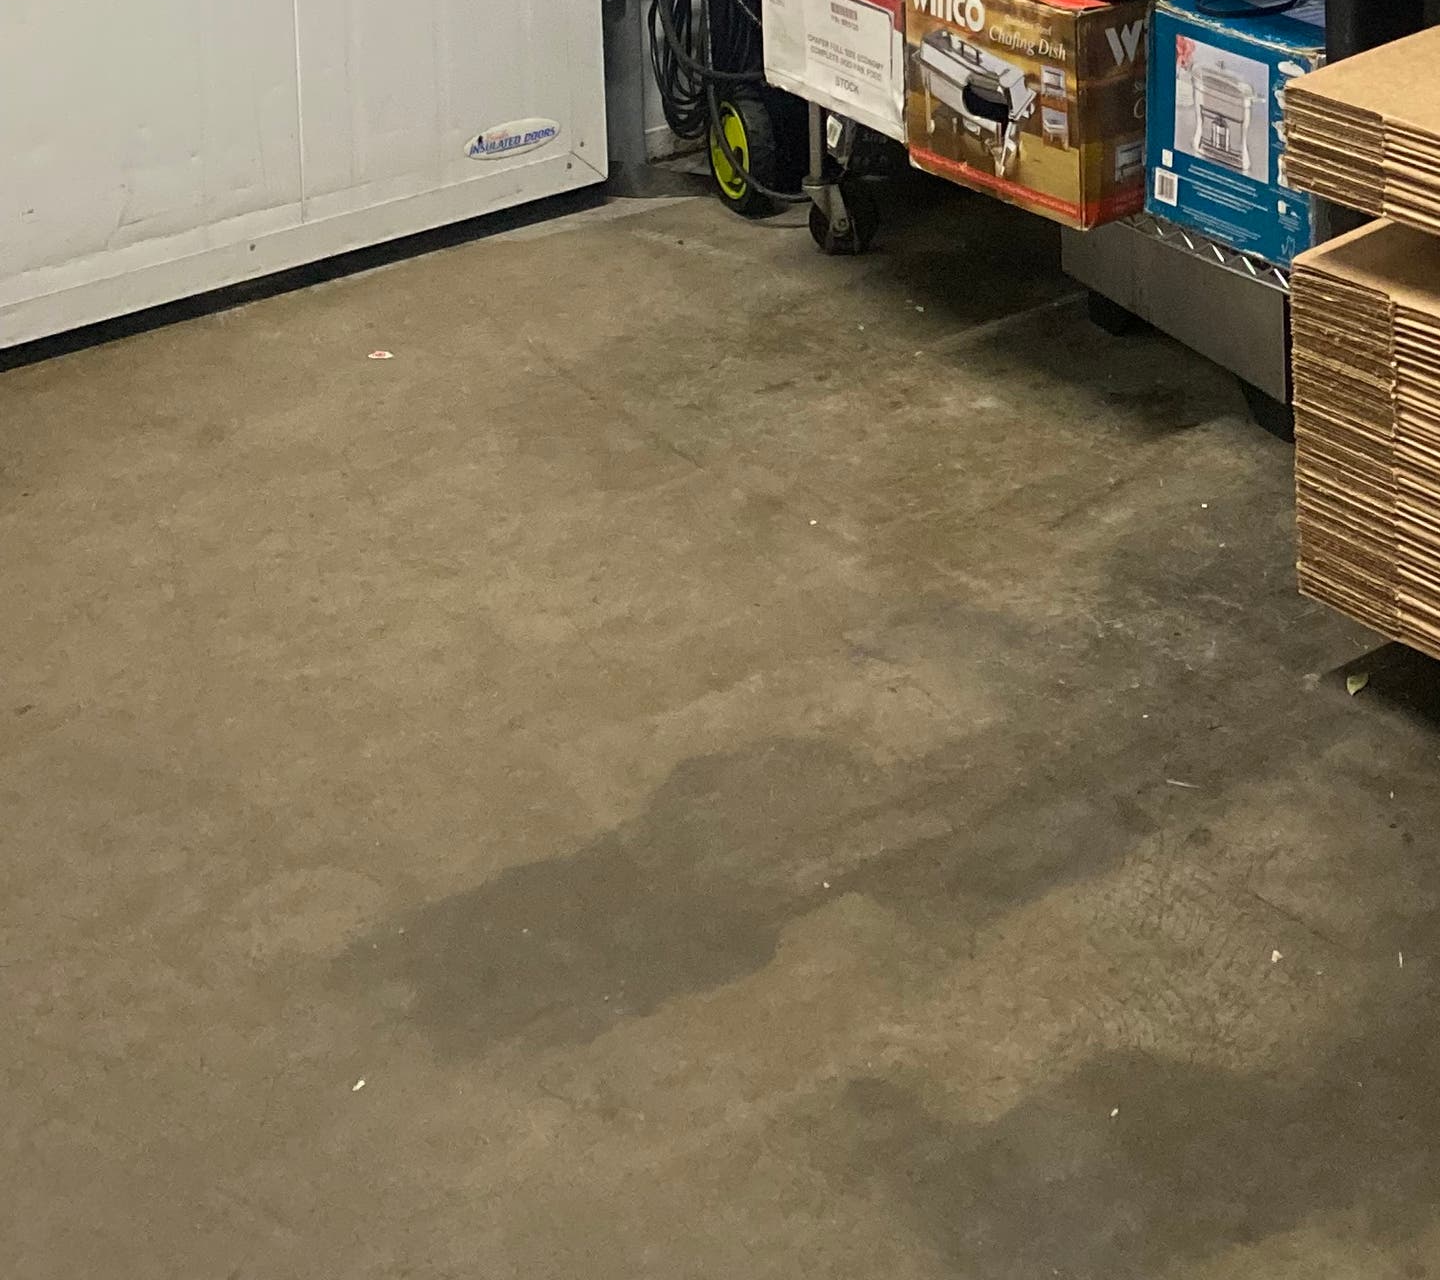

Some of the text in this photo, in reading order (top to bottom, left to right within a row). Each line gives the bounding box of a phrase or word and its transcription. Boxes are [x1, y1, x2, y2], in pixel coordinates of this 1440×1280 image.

[988, 25, 1067, 61] Chafing Dish
[834, 75, 860, 95] STOCK
[523, 126, 557, 144] DOORS
